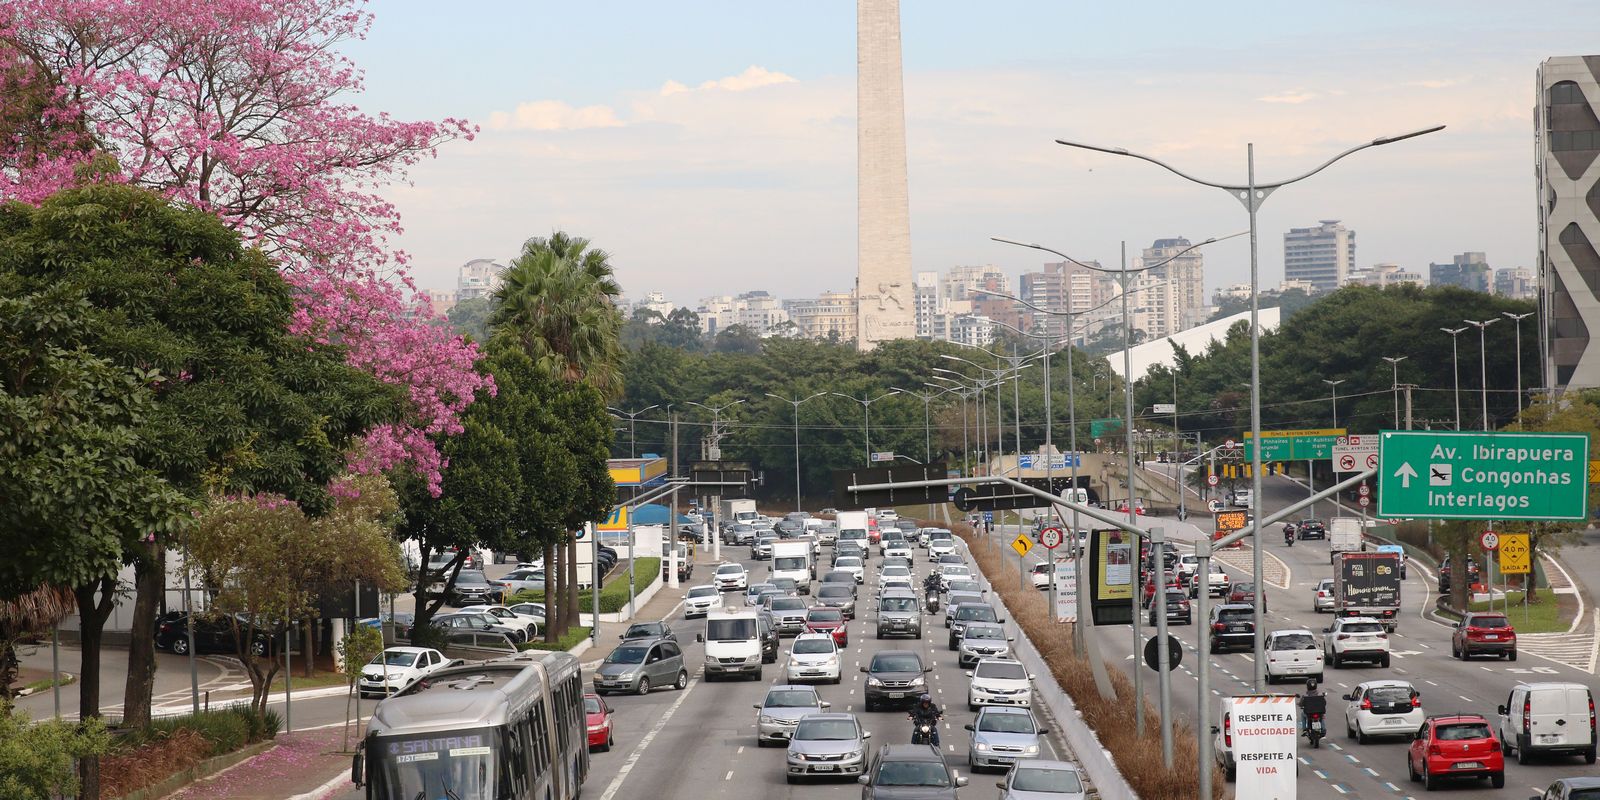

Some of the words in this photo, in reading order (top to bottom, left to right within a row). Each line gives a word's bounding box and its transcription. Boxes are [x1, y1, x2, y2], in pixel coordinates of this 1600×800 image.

[1430, 444, 1462, 460] Av.
[1474, 444, 1574, 464] Ibirapuera
[1461, 467, 1571, 488] Congonhas
[1428, 491, 1530, 511] Interlagos
[1237, 728, 1295, 736] VELOCIDADE
[403, 736, 480, 753] SANTANA
